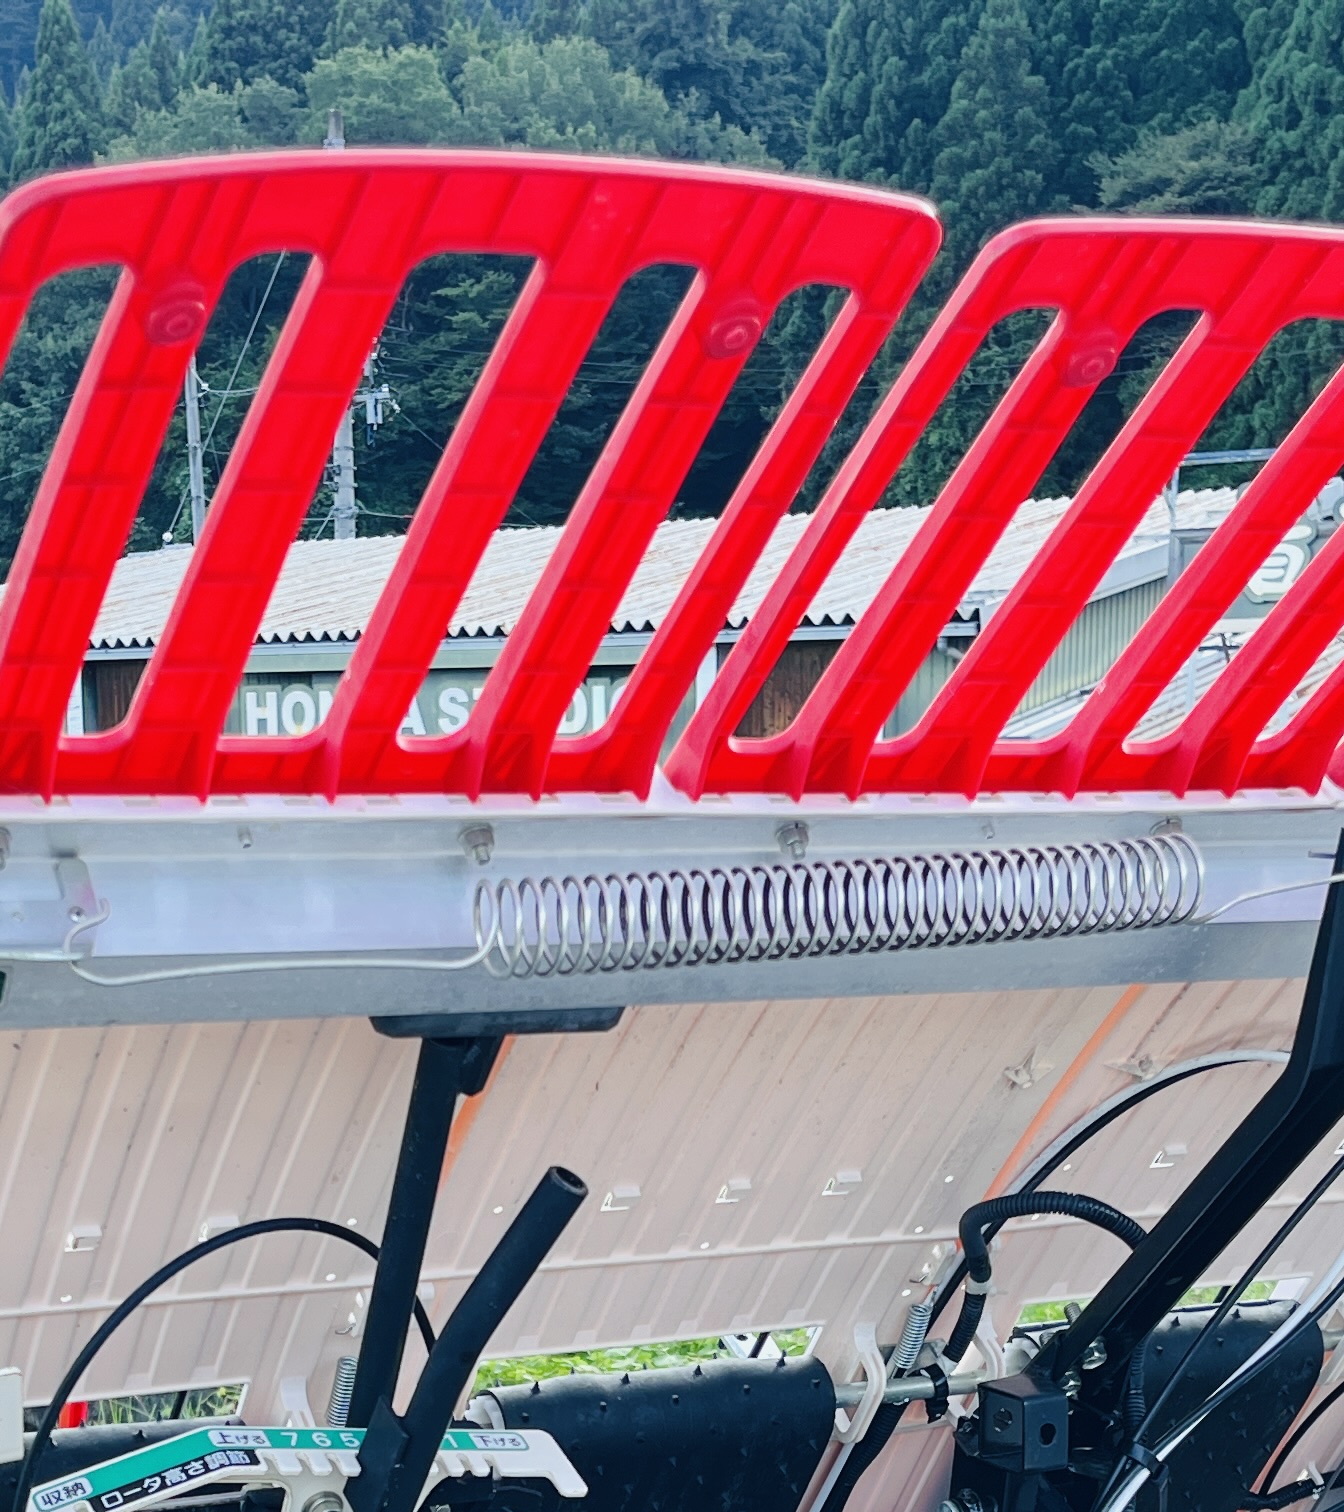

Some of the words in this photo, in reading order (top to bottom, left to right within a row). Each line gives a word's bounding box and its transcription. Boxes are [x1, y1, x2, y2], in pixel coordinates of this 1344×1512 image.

[215, 1431, 267, 1445] 上げる
[280, 1431, 298, 1447] 7
[311, 1431, 332, 1447] 6
[339, 1432, 361, 1448] 5
[472, 1434, 522, 1448] 下げる
[100, 1449, 251, 1510] ロータ高さ調節
[40, 1481, 87, 1506] 収納
